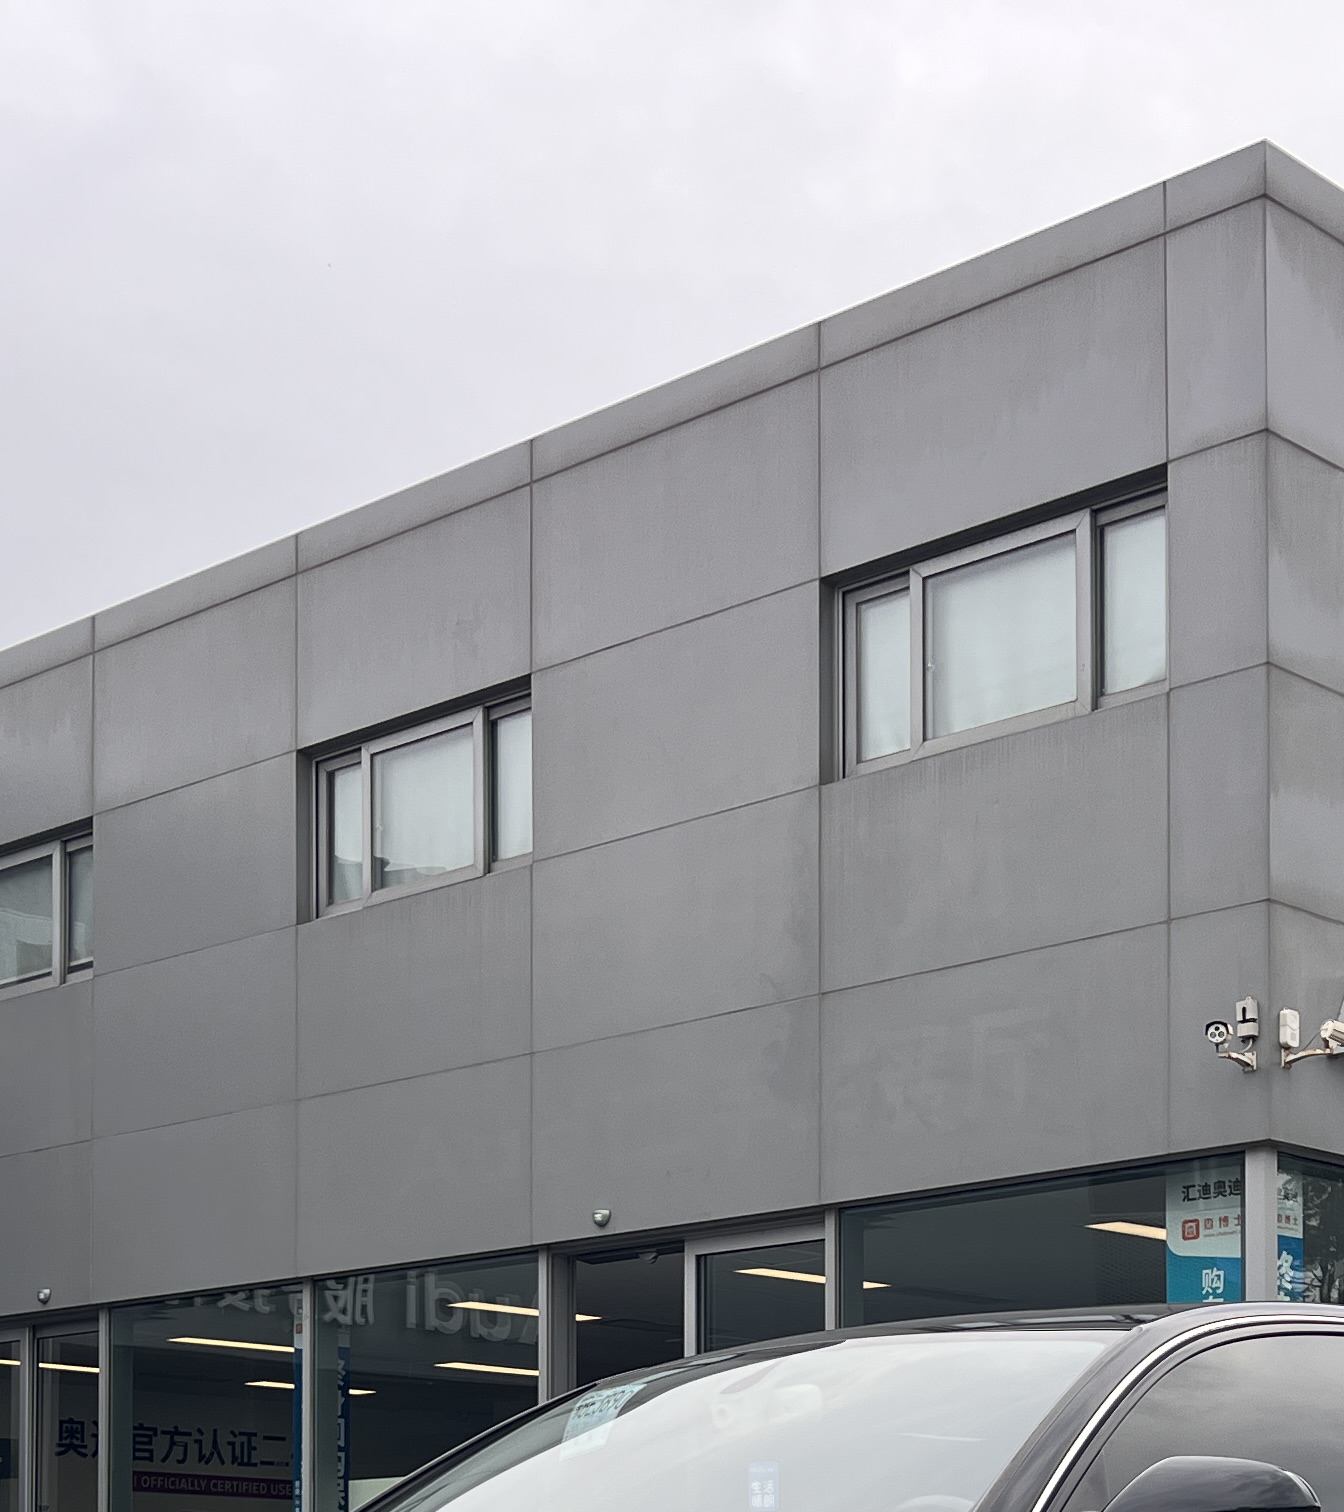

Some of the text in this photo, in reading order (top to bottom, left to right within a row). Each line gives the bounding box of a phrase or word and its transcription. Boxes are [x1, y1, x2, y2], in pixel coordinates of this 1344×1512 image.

[1201, 1266, 1226, 1303] 购
[141, 1474, 208, 1491] OFFICIALLY
[210, 1478, 267, 1496] CERTIFIED
